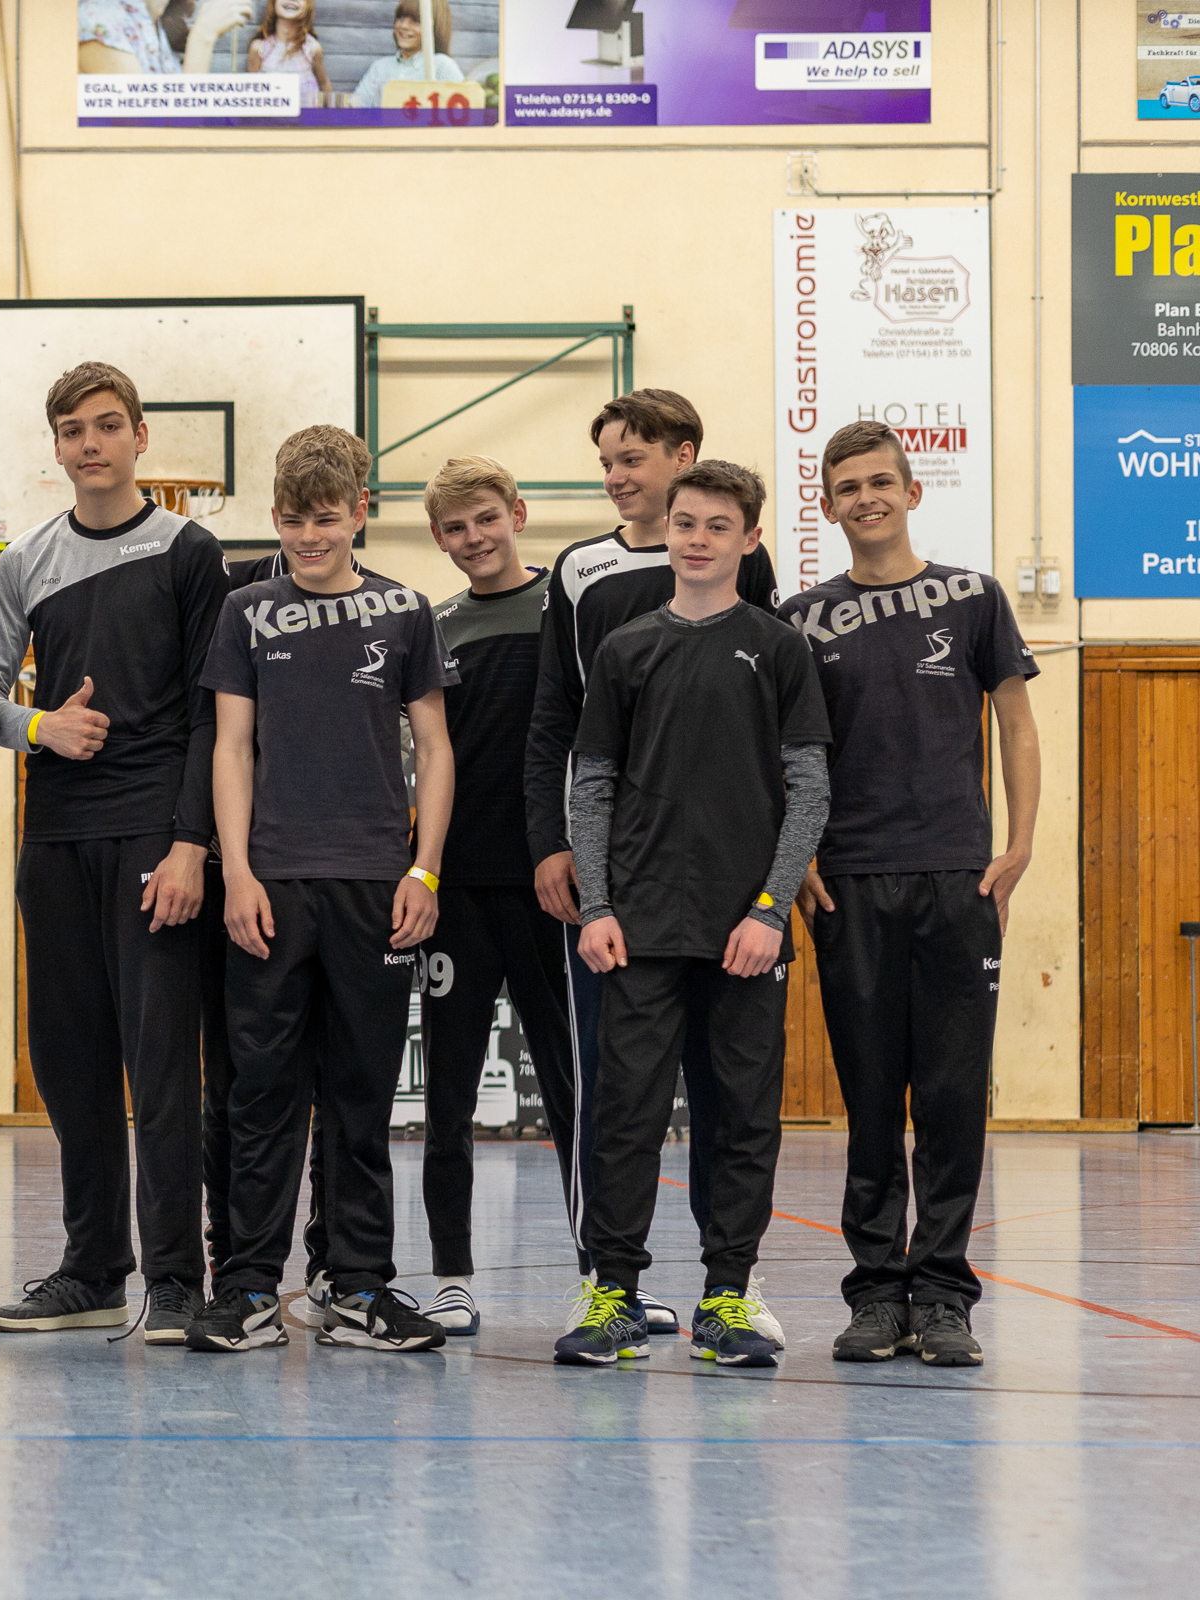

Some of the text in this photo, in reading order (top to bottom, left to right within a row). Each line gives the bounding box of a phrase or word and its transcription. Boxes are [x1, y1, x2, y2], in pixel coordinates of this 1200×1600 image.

[823, 40, 909, 60] ADASYS
[807, 64, 921, 79] We help to sell
[84, 82, 270, 95] EGAL, WAS SIE VERKAUFEN
[84, 97, 290, 108] WIR HELFEN BEIM KASSIEREN
[514, 92, 650, 104] Telefon 07154 8300-0
[514, 107, 613, 119] www.adasys.de
[1115, 214, 1200, 276] Pla
[885, 284, 958, 302] Hasen
[1155, 303, 1190, 317] Plan
[788, 213, 817, 434] Gastronomie
[1131, 342, 1178, 356] 70806
[858, 403, 967, 426] HOTEL
[898, 428, 968, 452] MIZIL
[120, 539, 161, 556] Kempa
[577, 557, 619, 579] Kempa
[244, 587, 420, 650] Kempa
[436, 603, 459, 621] mpa
[790, 573, 985, 652] Kempa
[266, 650, 292, 661] Lukas
[823, 652, 841, 663] Luis
[519, 1093, 543, 1107] hello
